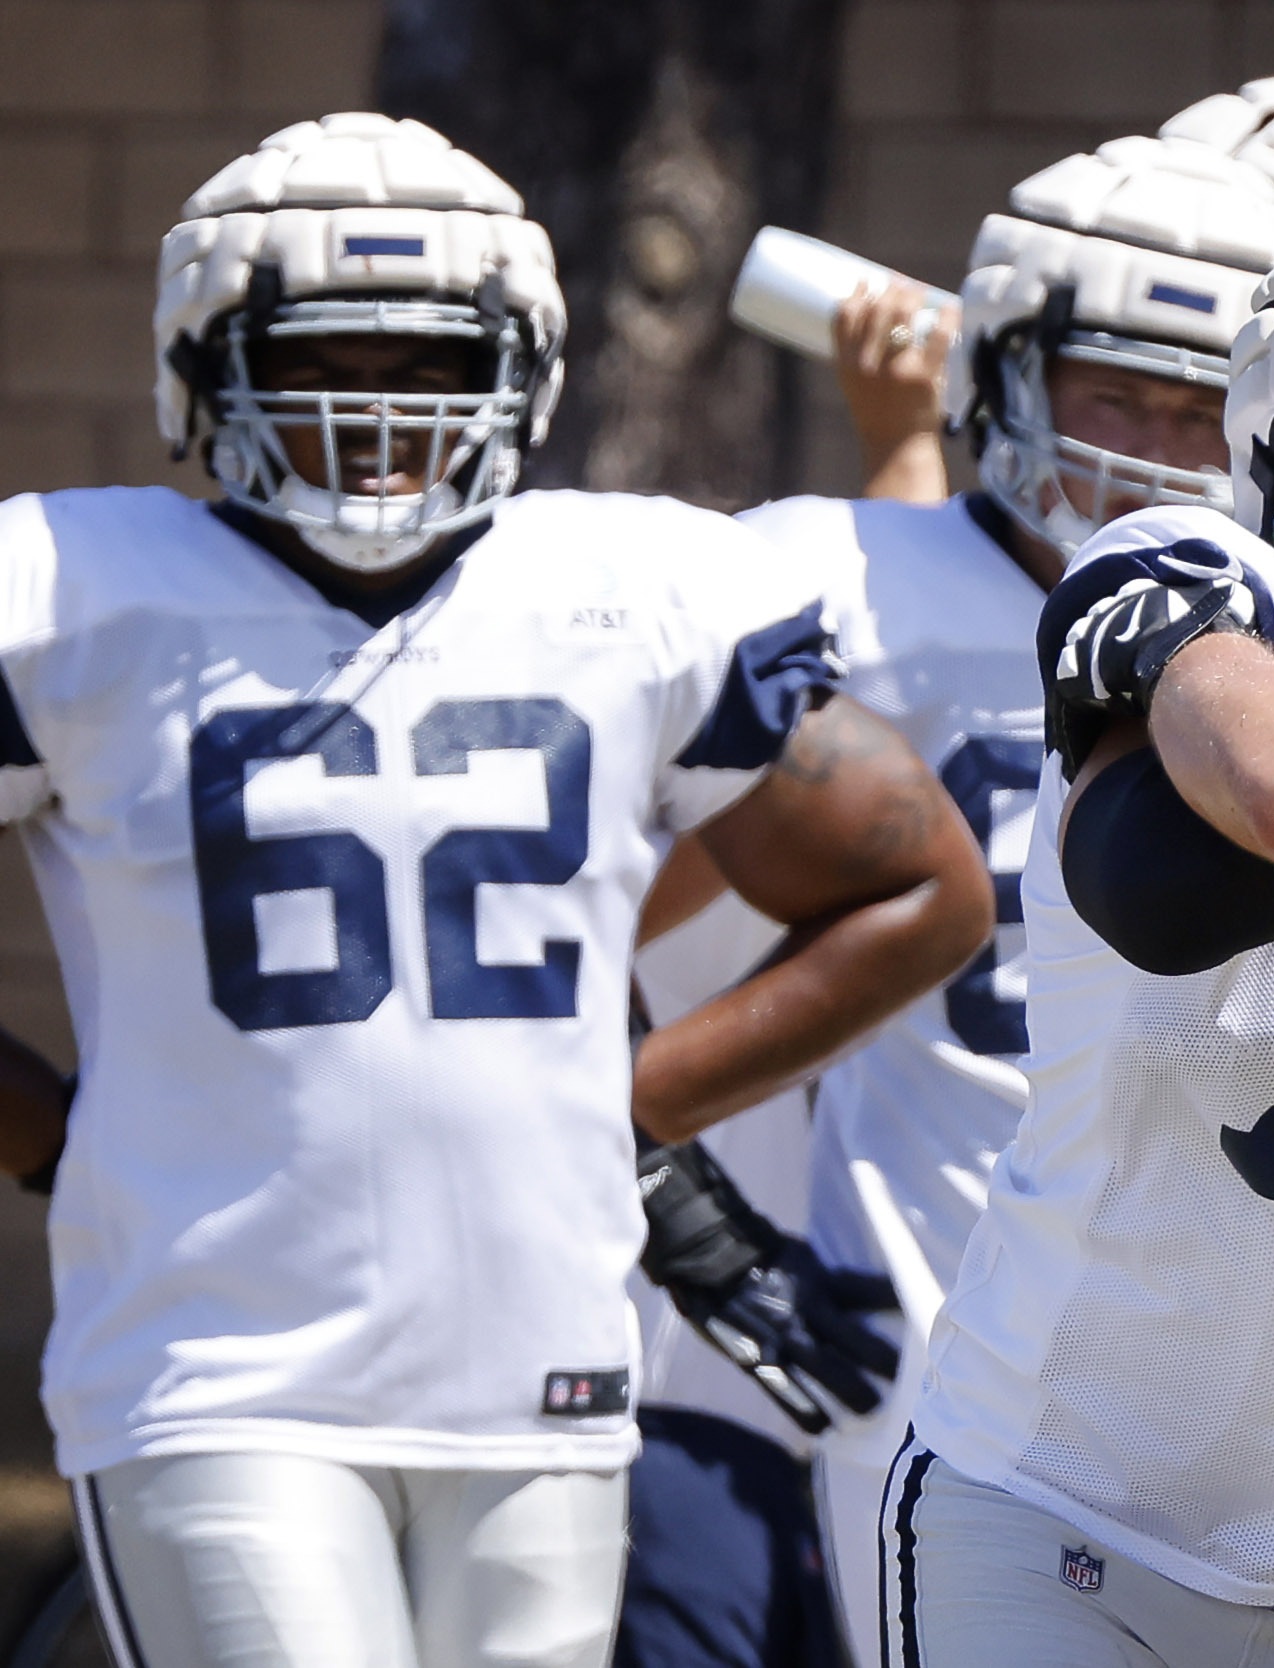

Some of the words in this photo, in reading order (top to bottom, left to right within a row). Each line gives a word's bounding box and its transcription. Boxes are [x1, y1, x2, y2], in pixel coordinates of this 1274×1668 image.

[568, 607, 630, 630] AT&T
[328, 645, 442, 668] COWOYS
[188, 696, 592, 1032] 62
[1067, 1562, 1098, 1587] NFL
